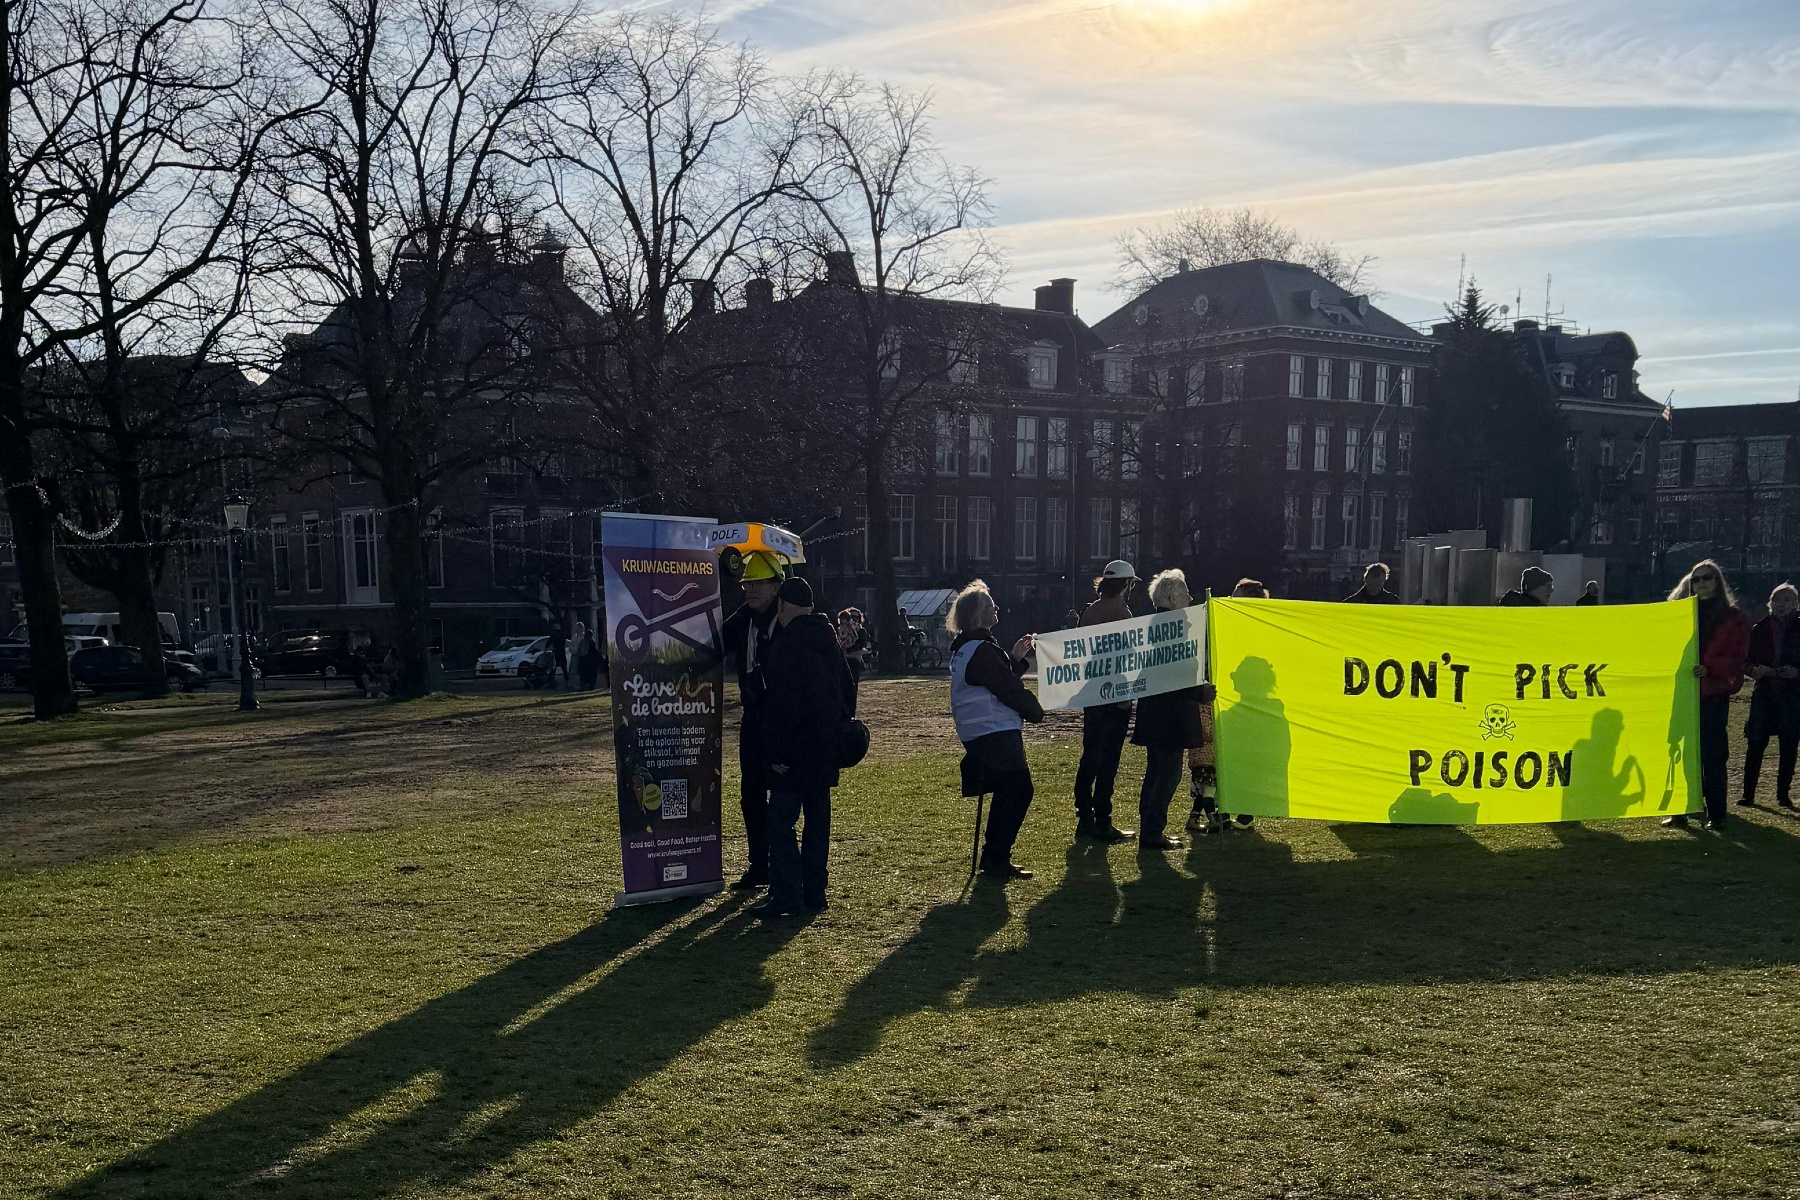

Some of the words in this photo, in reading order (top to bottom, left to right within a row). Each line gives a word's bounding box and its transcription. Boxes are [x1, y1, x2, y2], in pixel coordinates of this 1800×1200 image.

[711, 529, 740, 542] DOLF,
[622, 559, 713, 575] KRUIWAGENMARS
[1063, 639, 1087, 660] EEN
[1089, 628, 1144, 656] LEEFBARE
[1147, 619, 1184, 645] AARDE
[1046, 664, 1081, 685] VOOR
[1084, 657, 1112, 680] ALLE
[1114, 639, 1199, 675] KLEINKINDEREN
[1343, 652, 1470, 703] DON'T
[1514, 663, 1609, 700] PICK
[631, 697, 650, 716] de
[651, 692, 716, 715] bodem!
[636, 727, 651, 737] Een
[651, 726, 681, 736] levende
[681, 725, 706, 735] bodem
[638, 737, 644, 747] is
[645, 737, 654, 747] de
[655, 736, 690, 748] oplossing
[690, 737, 706, 745] voor
[674, 746, 701, 756] klimaat
[646, 760, 656, 768] en
[1408, 749, 1574, 790] POISON
